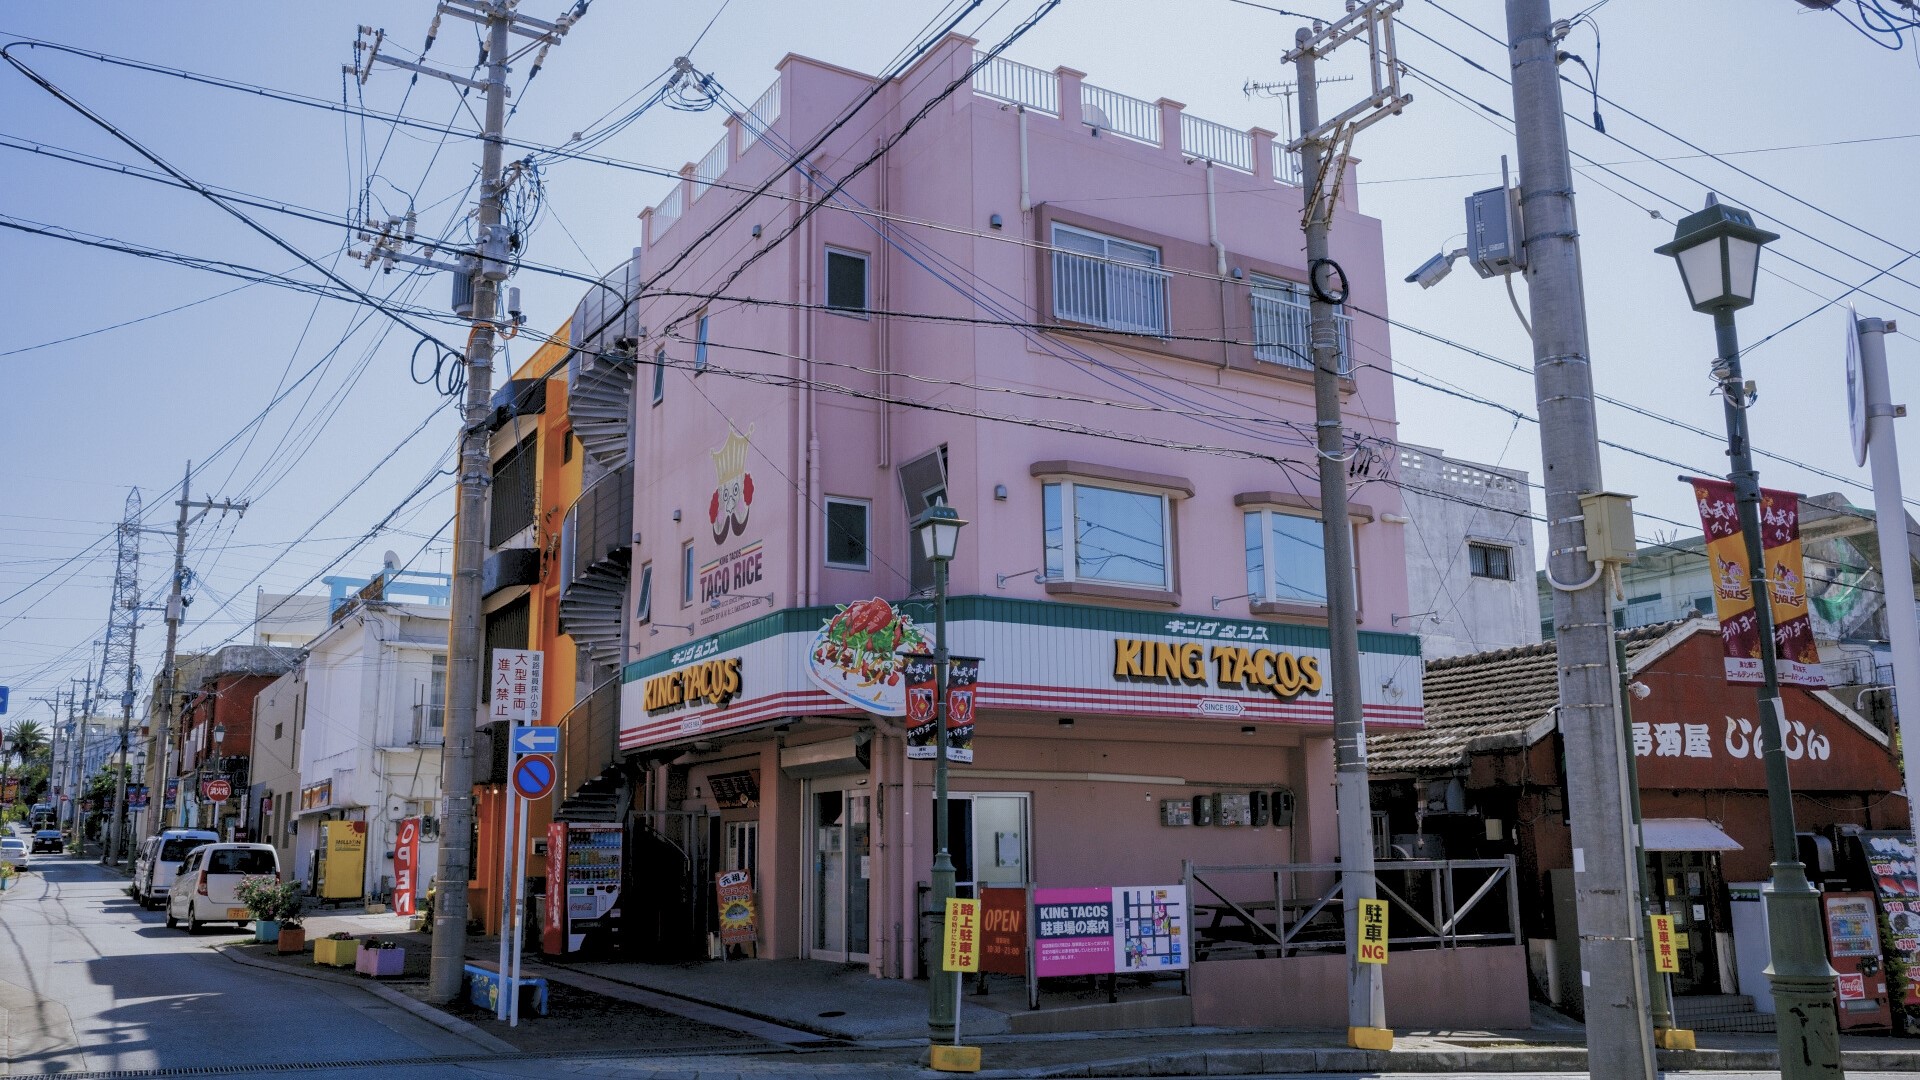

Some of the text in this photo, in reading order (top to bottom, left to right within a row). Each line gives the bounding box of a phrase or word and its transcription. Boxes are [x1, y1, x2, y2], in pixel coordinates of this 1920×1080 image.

[1711, 521, 1732, 535] から
[1775, 528, 1791, 542] から
[699, 552, 763, 604] TACO RICE
[1718, 586, 1750, 600] EAGLES
[1772, 592, 1804, 607] EAGLES
[1115, 637, 1322, 697] KING TACOS
[513, 653, 528, 711] 大型車両
[642, 657, 739, 712] KING TACOS
[914, 674, 927, 682] から
[495, 658, 511, 716] 進入禁止
[1204, 703, 1239, 712] SINCE 1984
[1632, 722, 1713, 757] 居酒屋
[209, 786, 229, 796] 消火栓
[984, 908, 1020, 933] OPEN
[1040, 905, 1109, 920] KING TACOS
[1040, 919, 1110, 936] 駐車場の案内
[1364, 903, 1383, 943] 駐車
[958, 903, 974, 967] 路上駐車は
[1656, 918, 1673, 969] 駐車禁止
[1361, 944, 1385, 960] NG
[1840, 978, 1864, 992] Coca-Cola
